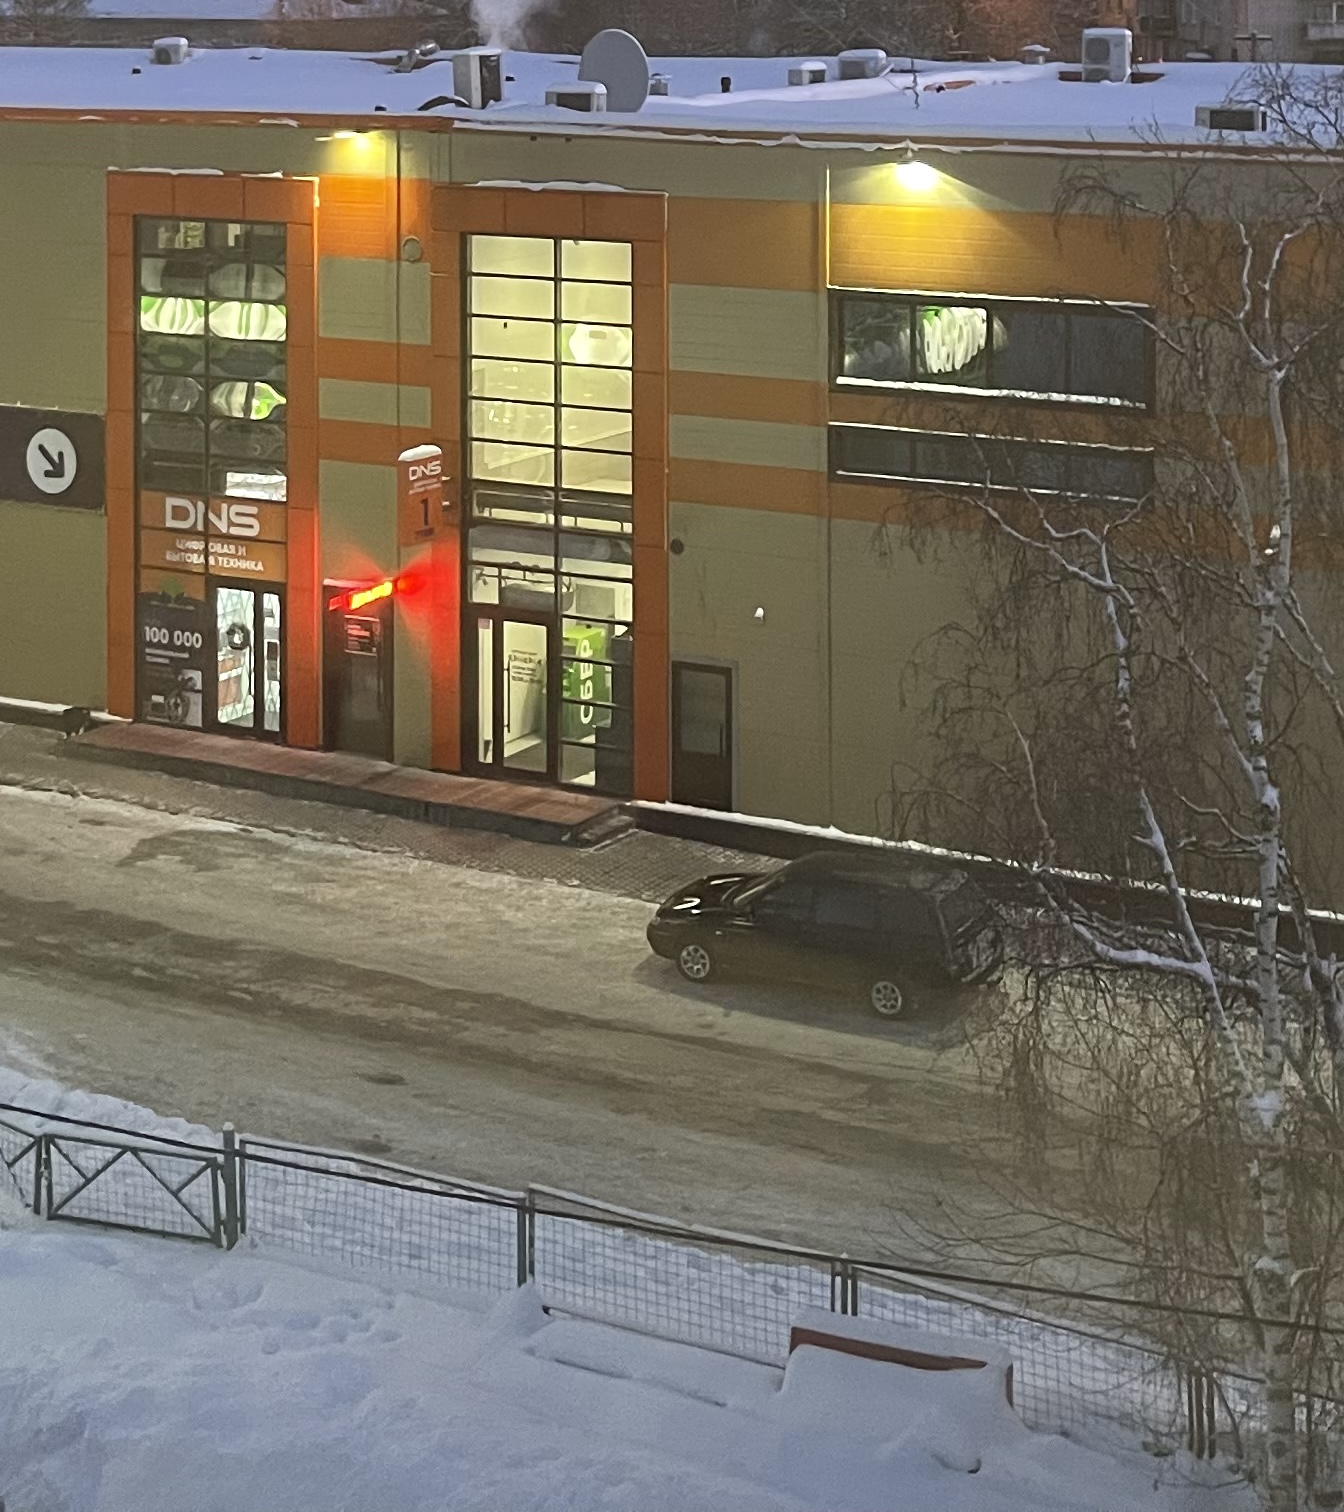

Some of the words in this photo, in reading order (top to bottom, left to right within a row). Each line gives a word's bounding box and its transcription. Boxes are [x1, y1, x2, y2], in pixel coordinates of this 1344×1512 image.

[408, 460, 442, 481] DNS
[165, 496, 261, 537] DNS
[420, 498, 429, 526] 1
[143, 626, 170, 645] 100
[173, 630, 203, 649] 000
